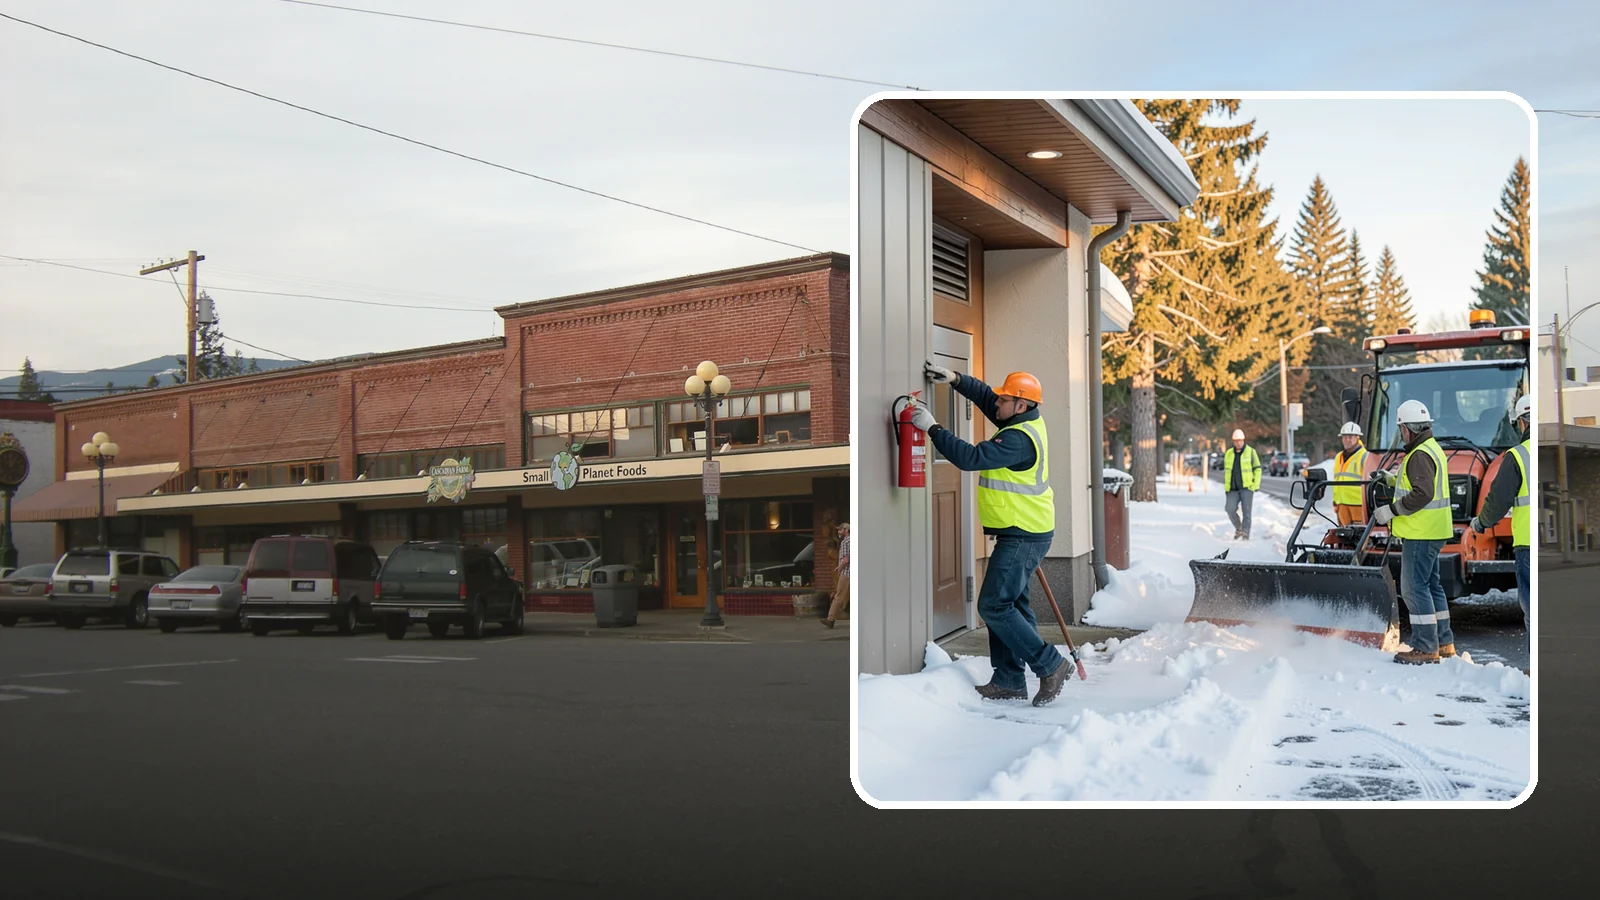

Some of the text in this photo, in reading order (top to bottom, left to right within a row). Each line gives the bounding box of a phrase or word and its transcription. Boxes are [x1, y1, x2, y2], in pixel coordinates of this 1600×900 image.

[523, 464, 647, 483] Small Planet Foods
